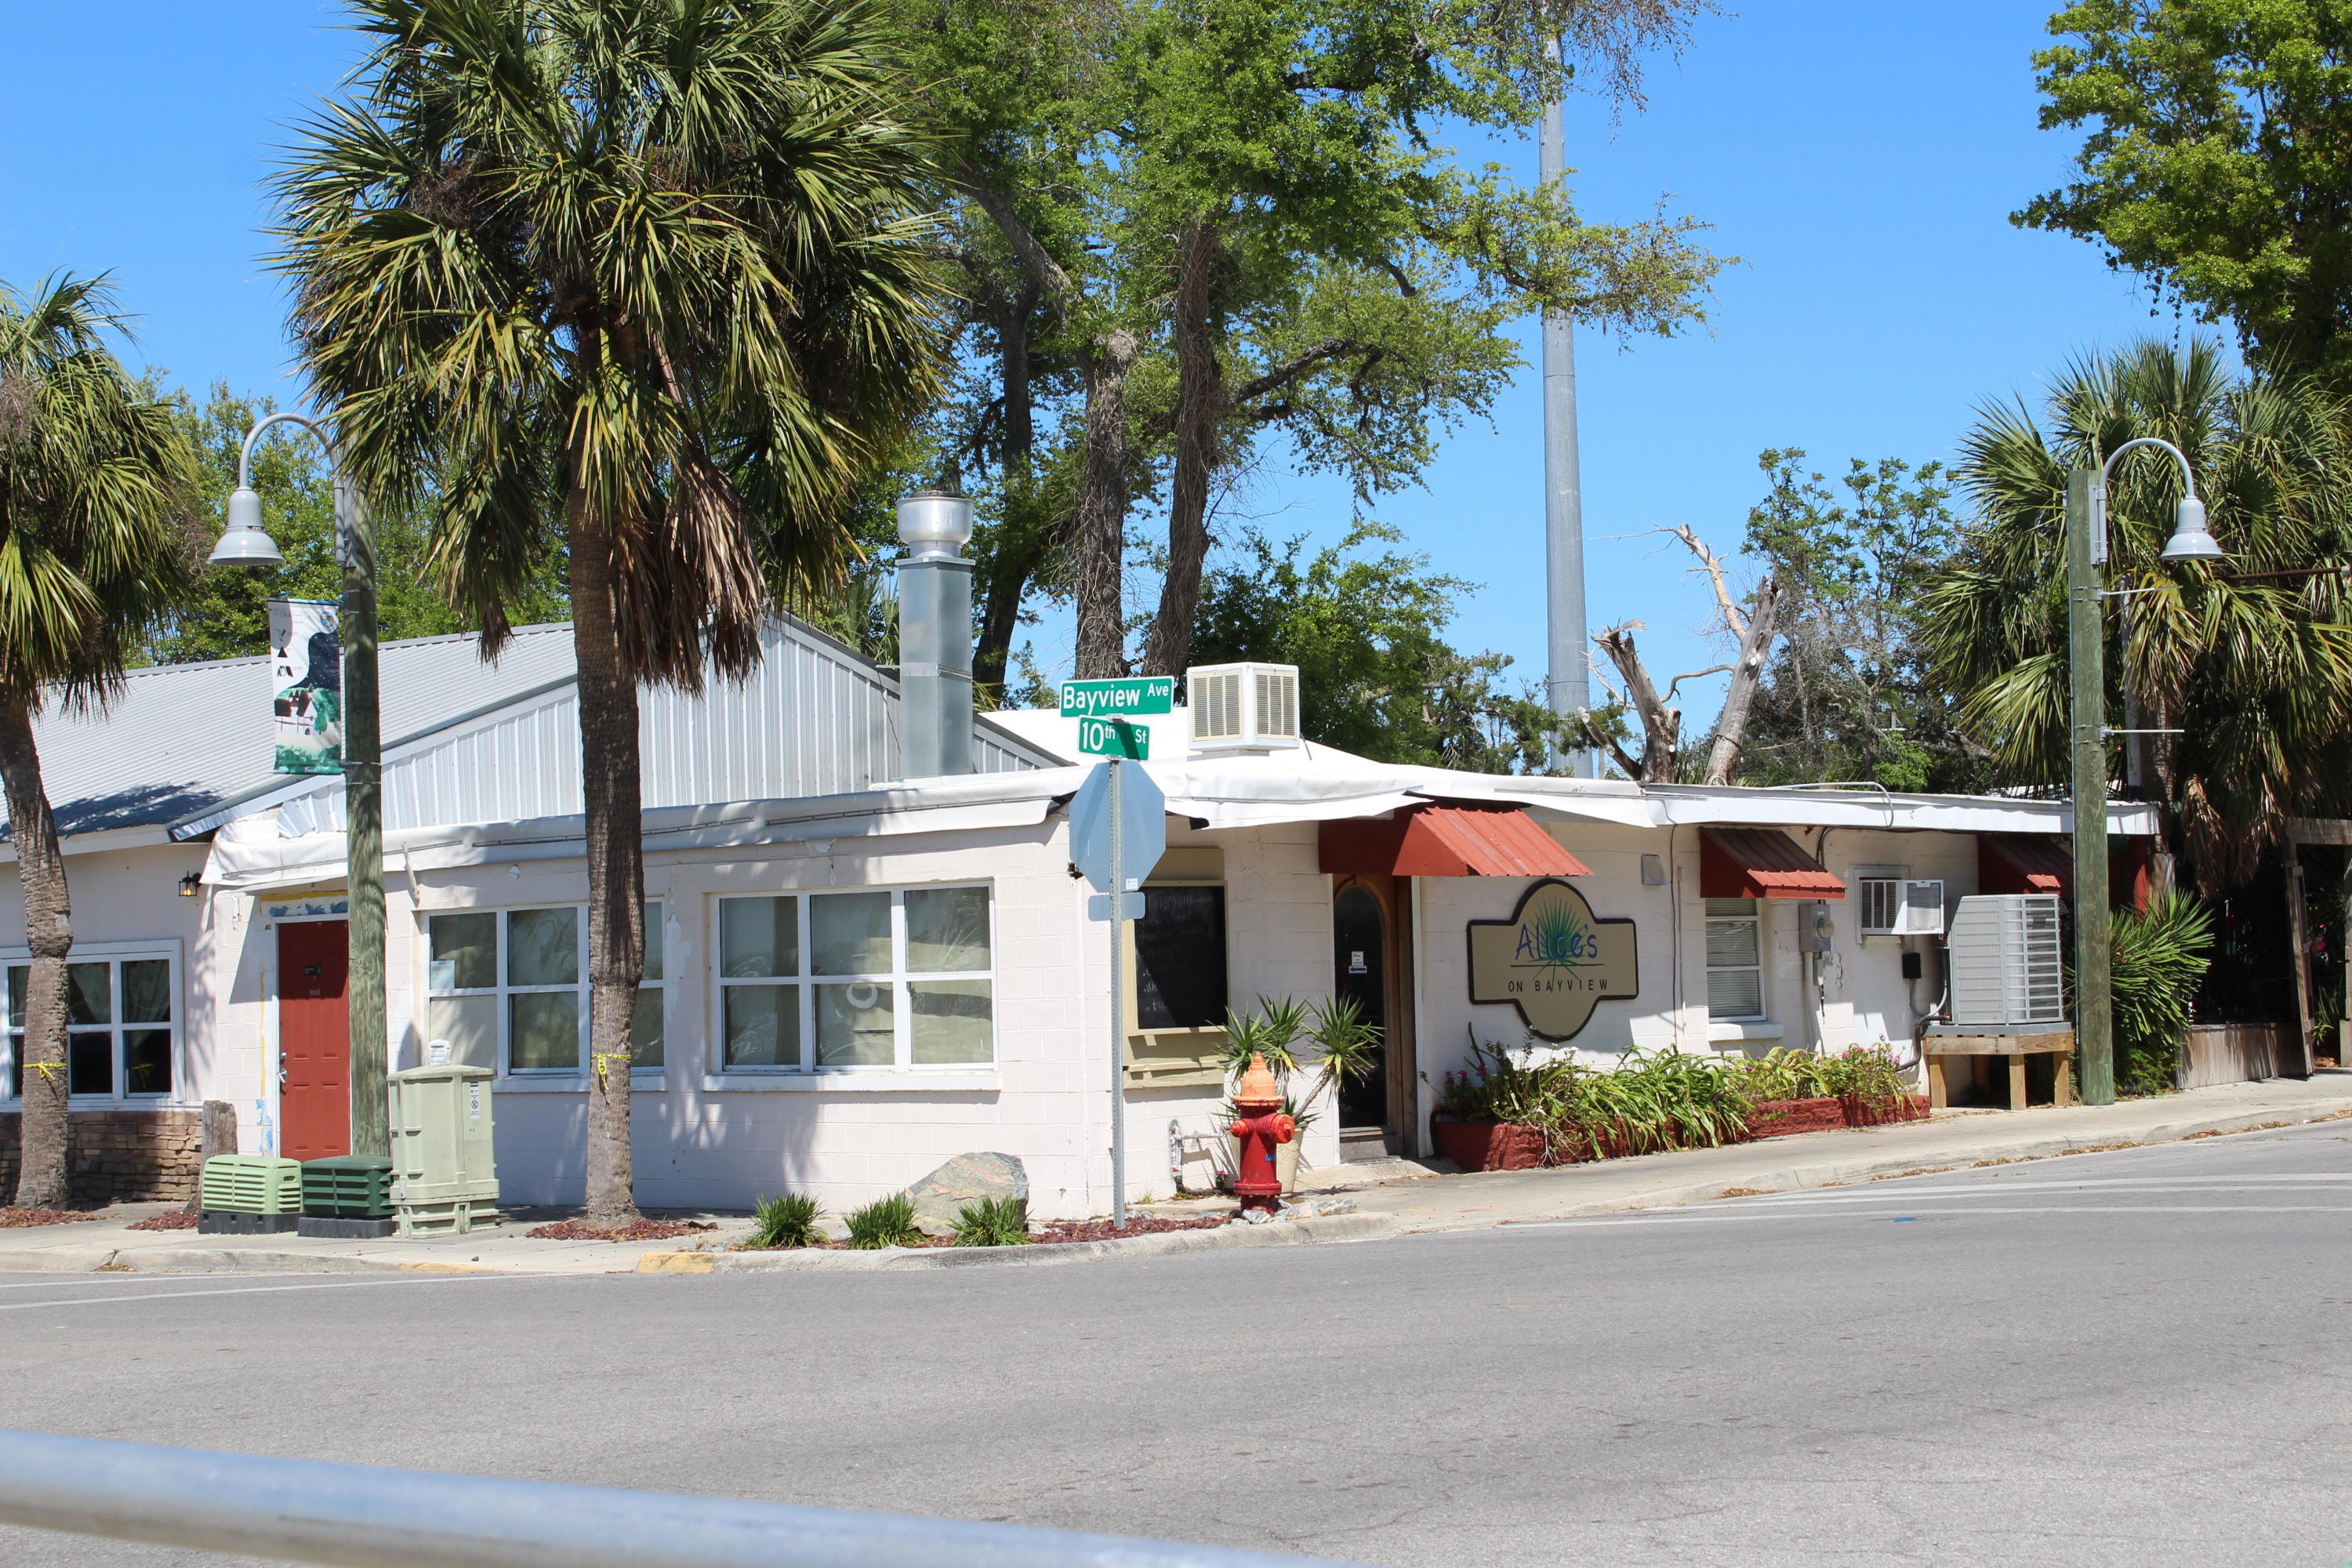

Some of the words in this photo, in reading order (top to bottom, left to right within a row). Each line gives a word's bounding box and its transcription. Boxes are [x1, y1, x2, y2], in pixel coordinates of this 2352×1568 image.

[1063, 684, 1141, 715] Bayview
[1147, 683, 1169, 697] Ave
[1083, 721, 1116, 751] 10th
[1135, 729, 1146, 744] St
[1515, 922, 1598, 960] Alice's
[1508, 981, 1523, 993] ON
[1534, 979, 1607, 993] BAYVIEW
